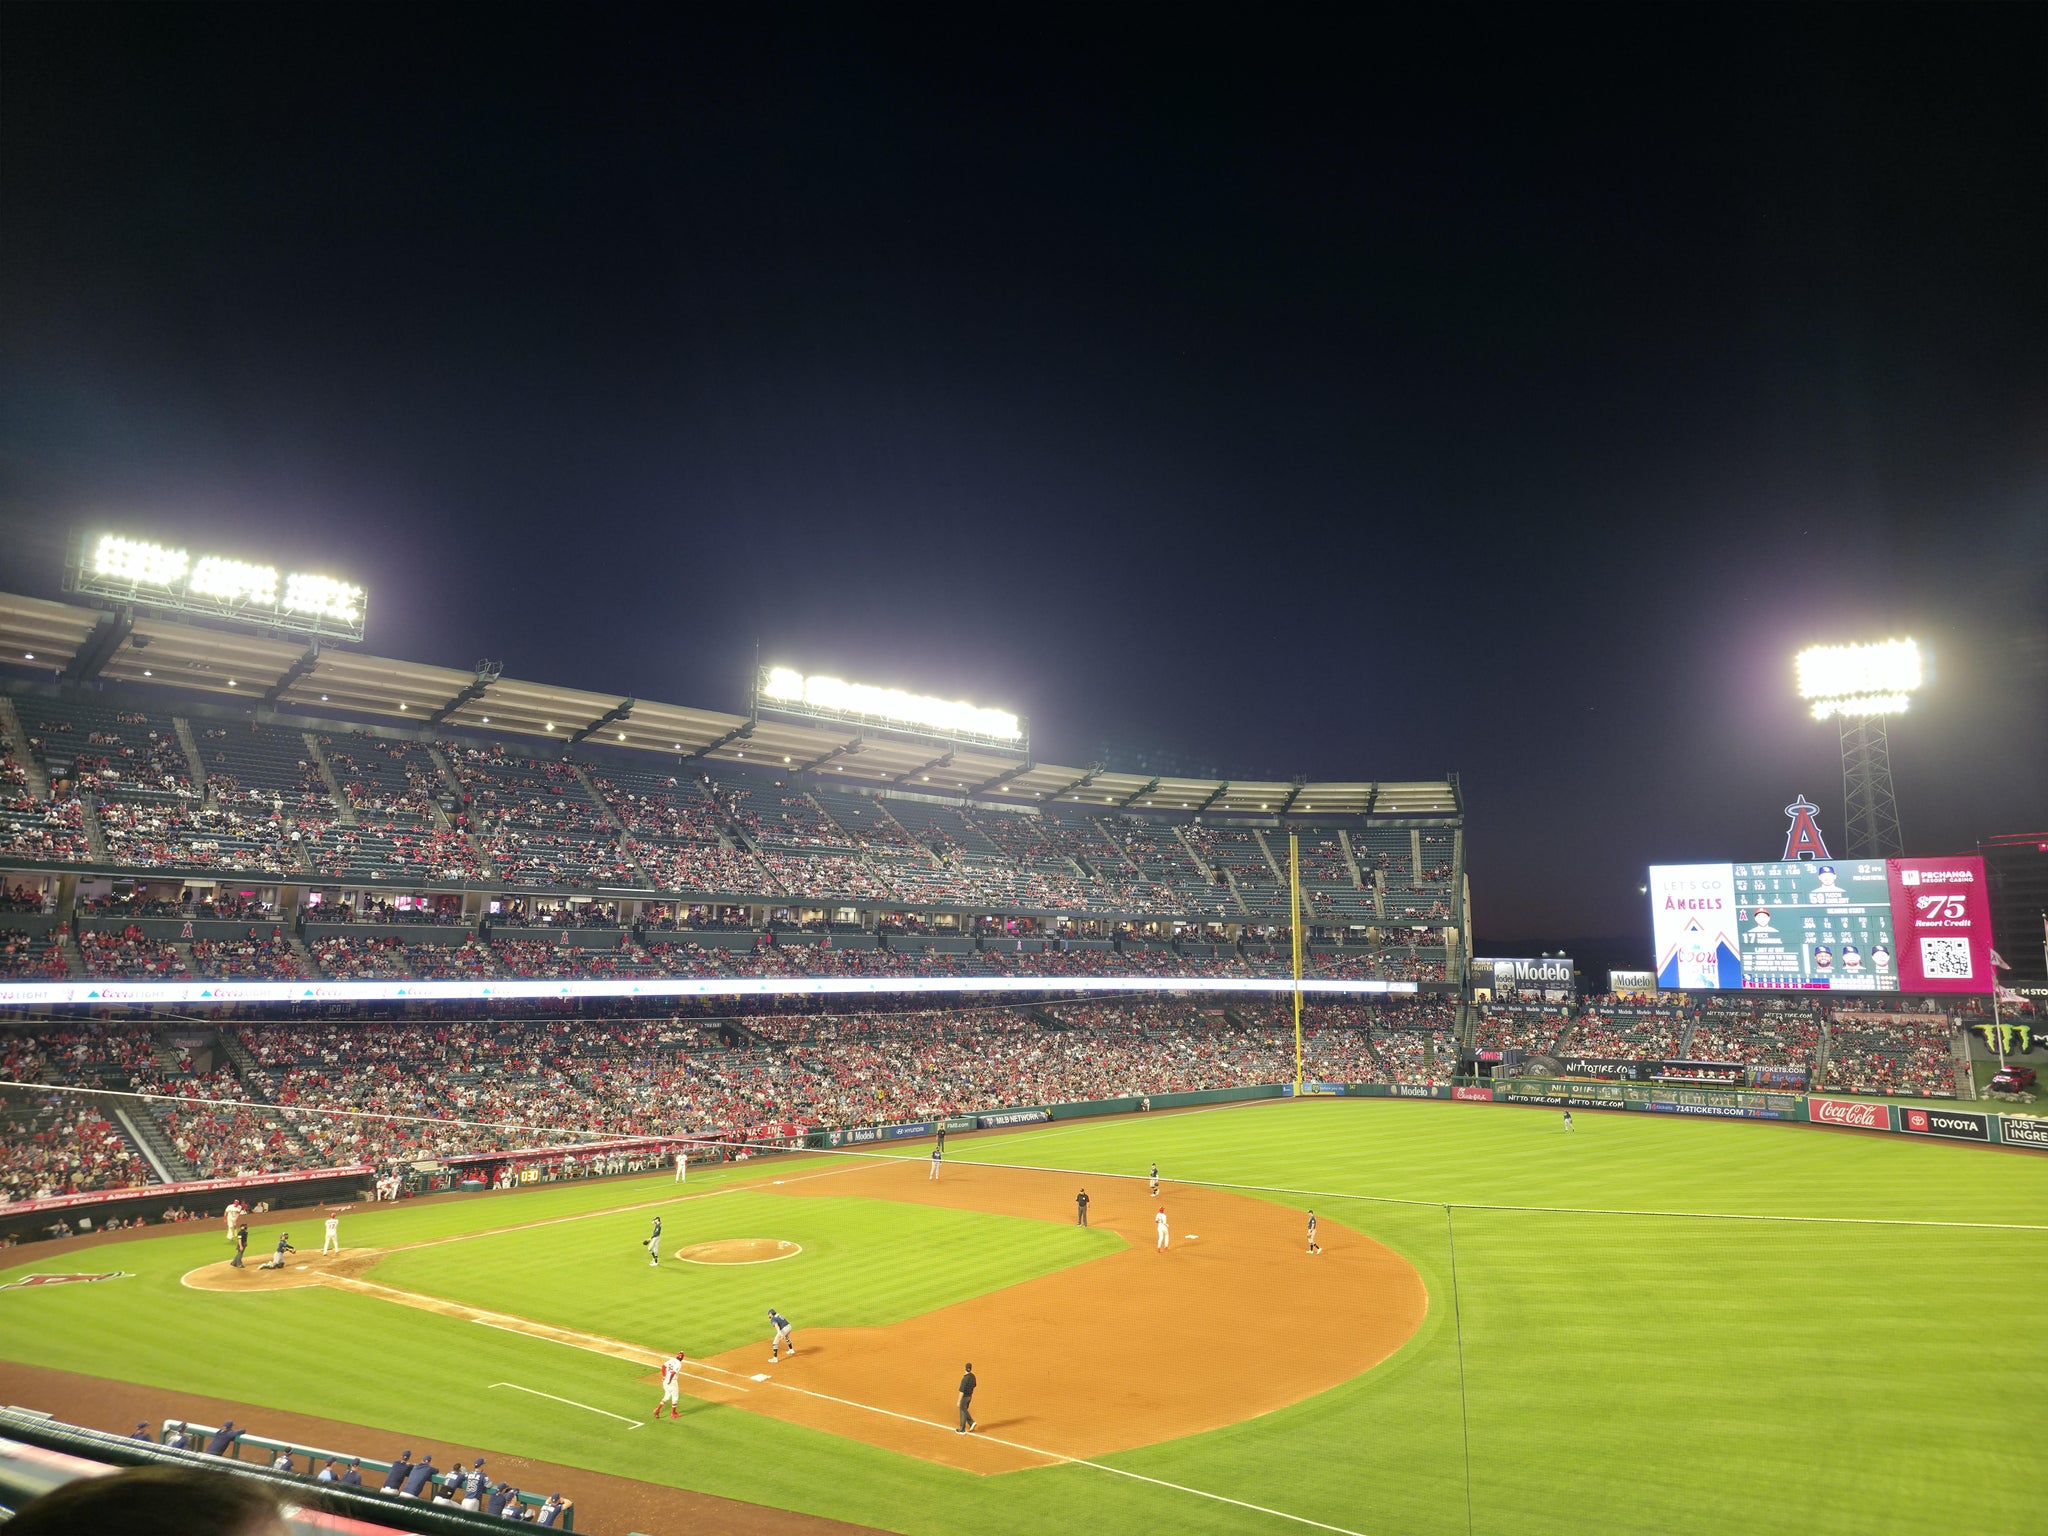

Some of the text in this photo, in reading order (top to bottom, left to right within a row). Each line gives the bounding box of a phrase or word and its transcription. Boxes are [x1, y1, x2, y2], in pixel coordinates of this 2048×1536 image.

[1702, 881, 1721, 889] GO
[1665, 893, 1723, 910] ANGELS
[1916, 895, 1966, 918] $75
[1742, 933, 1756, 944] 17
[1516, 962, 1570, 981] Modelo
[1617, 974, 1650, 987] Modelo
[1746, 1065, 1806, 1074] 714TICKETS.COM
[1401, 1086, 1427, 1096] Modelo
[1508, 1094, 1561, 1104] NITTO TIRE.COM
[1568, 1098, 1624, 1108] NITTO TIRE.COM
[1676, 1105, 1744, 1116] 714TICKETS.COM
[1819, 1101, 1876, 1126] Coca-Cola
[996, 1113, 1039, 1124] MLB NETWORK
[1931, 1117, 1979, 1132] TOYOTA
[2009, 1119, 2035, 1130] JUST
[855, 1131, 875, 1141] Modelo
